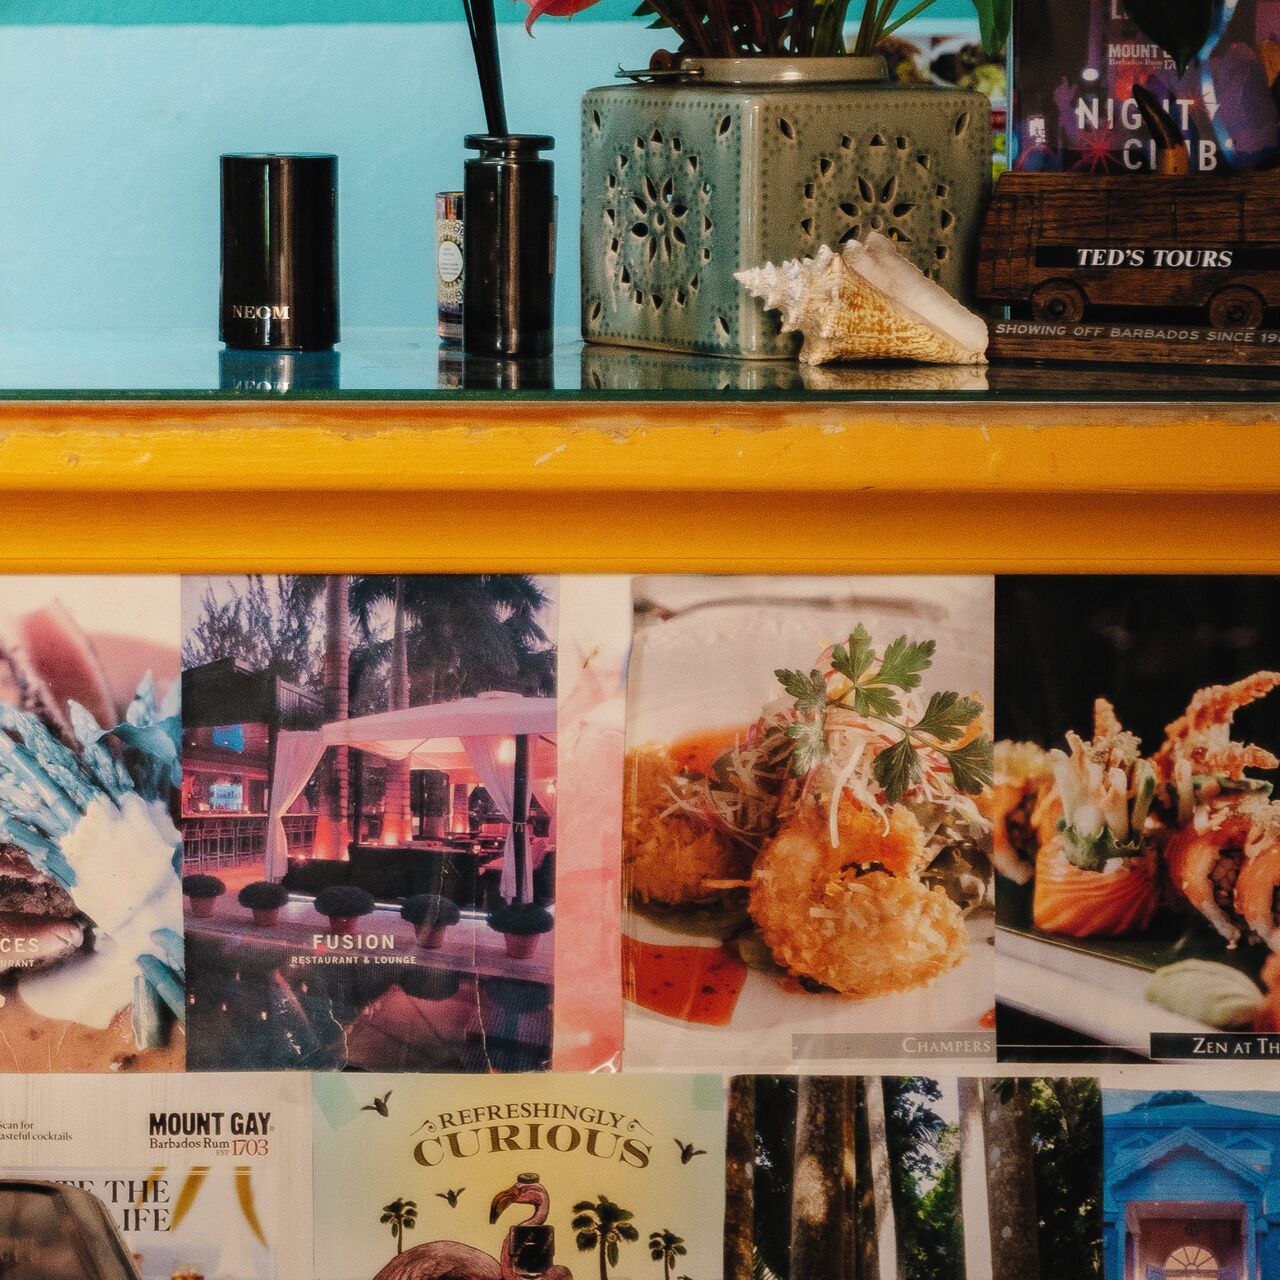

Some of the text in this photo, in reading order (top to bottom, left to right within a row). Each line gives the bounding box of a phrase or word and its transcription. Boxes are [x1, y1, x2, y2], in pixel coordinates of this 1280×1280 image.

[1077, 248, 1233, 268] TED'S TOURS
[232, 305, 290, 320] NEOM
[996, 324, 1280, 343] SHOWING OFF BARBADOS SINCE 19
[313, 934, 395, 950] FUSION
[291, 956, 417, 964] RESTAURANT & LOUNGE
[19, 1120, 34, 1130] for
[149, 1112, 271, 1136] MOUNT GAY
[438, 1102, 626, 1130] REFRESHINGLY
[32, 1131, 72, 1141] cocktails
[149, 1137, 229, 1150] Barbados Rum
[231, 1138, 269, 1156] 1703
[413, 1123, 652, 1169] CURIOUS
[105, 1180, 171, 1203] THE
[120, 1208, 171, 1232] IFE
